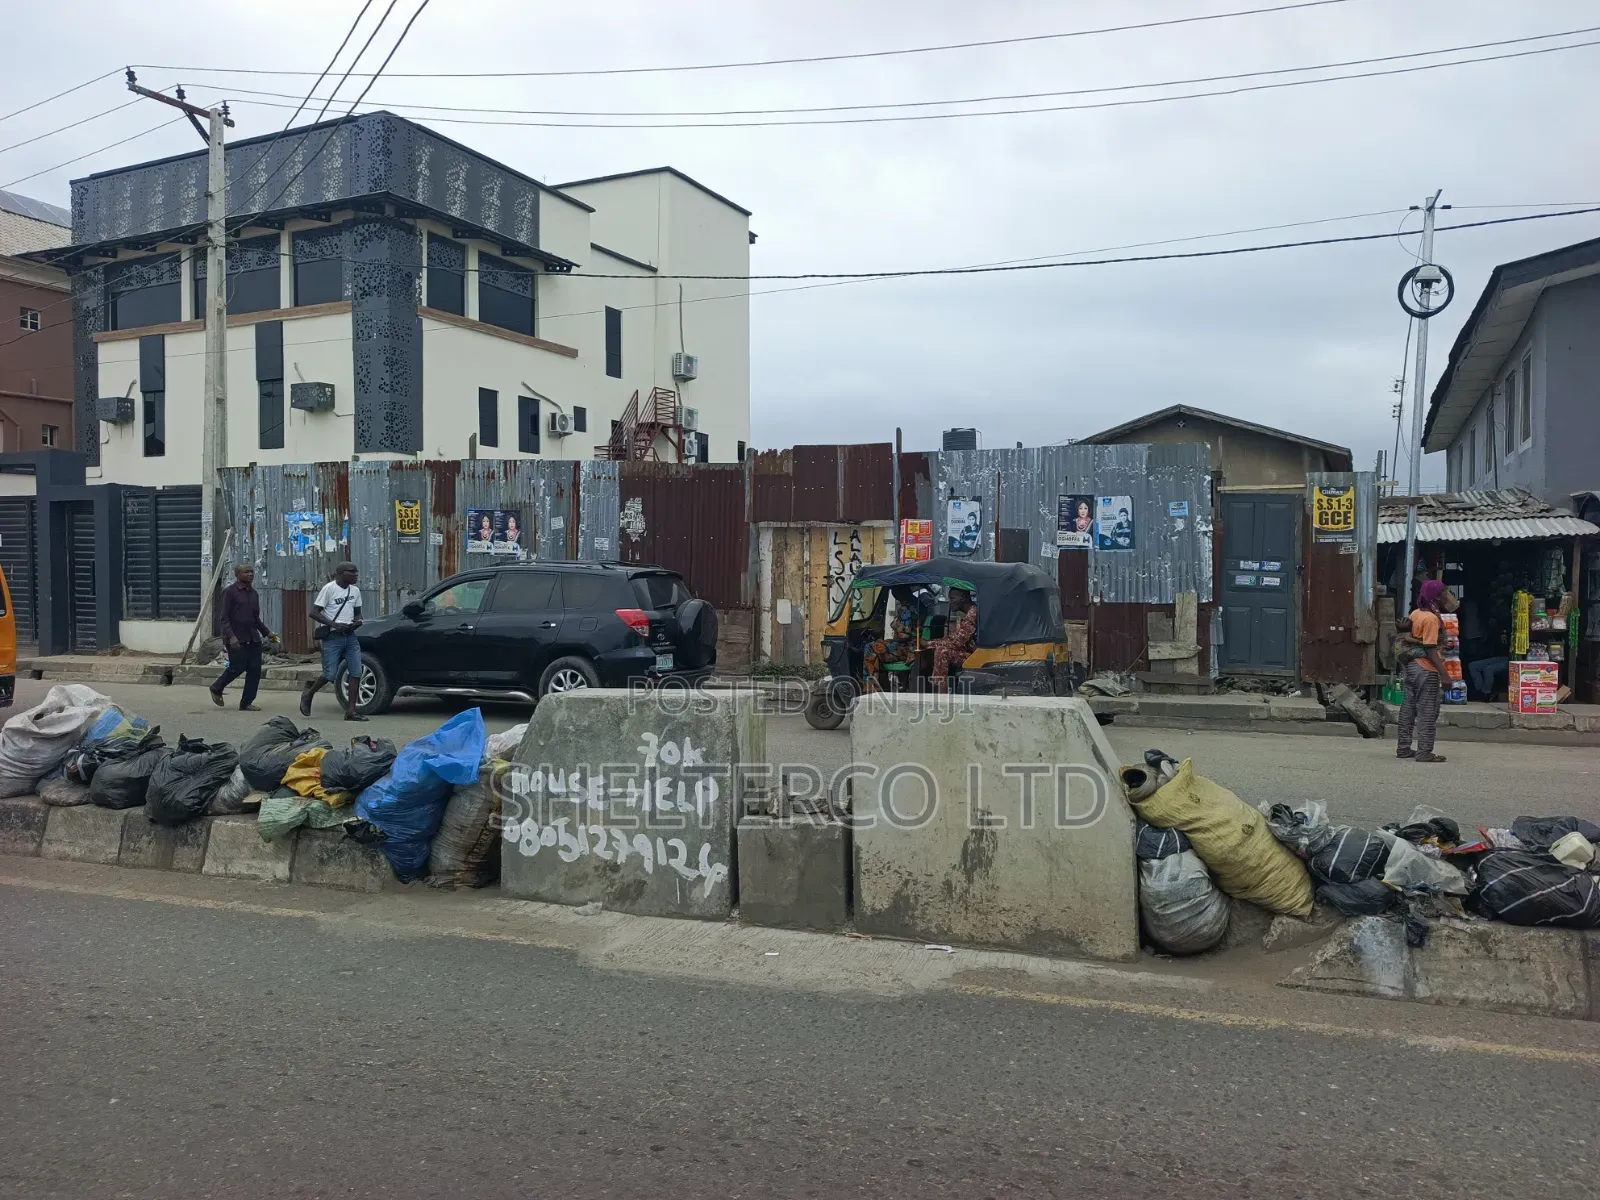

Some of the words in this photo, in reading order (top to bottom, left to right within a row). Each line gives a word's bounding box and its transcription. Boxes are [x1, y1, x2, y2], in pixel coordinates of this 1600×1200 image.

[1316, 497, 1353, 511] S.S.1-3
[399, 518, 419, 530] GCE
[1318, 510, 1352, 526] GCE
